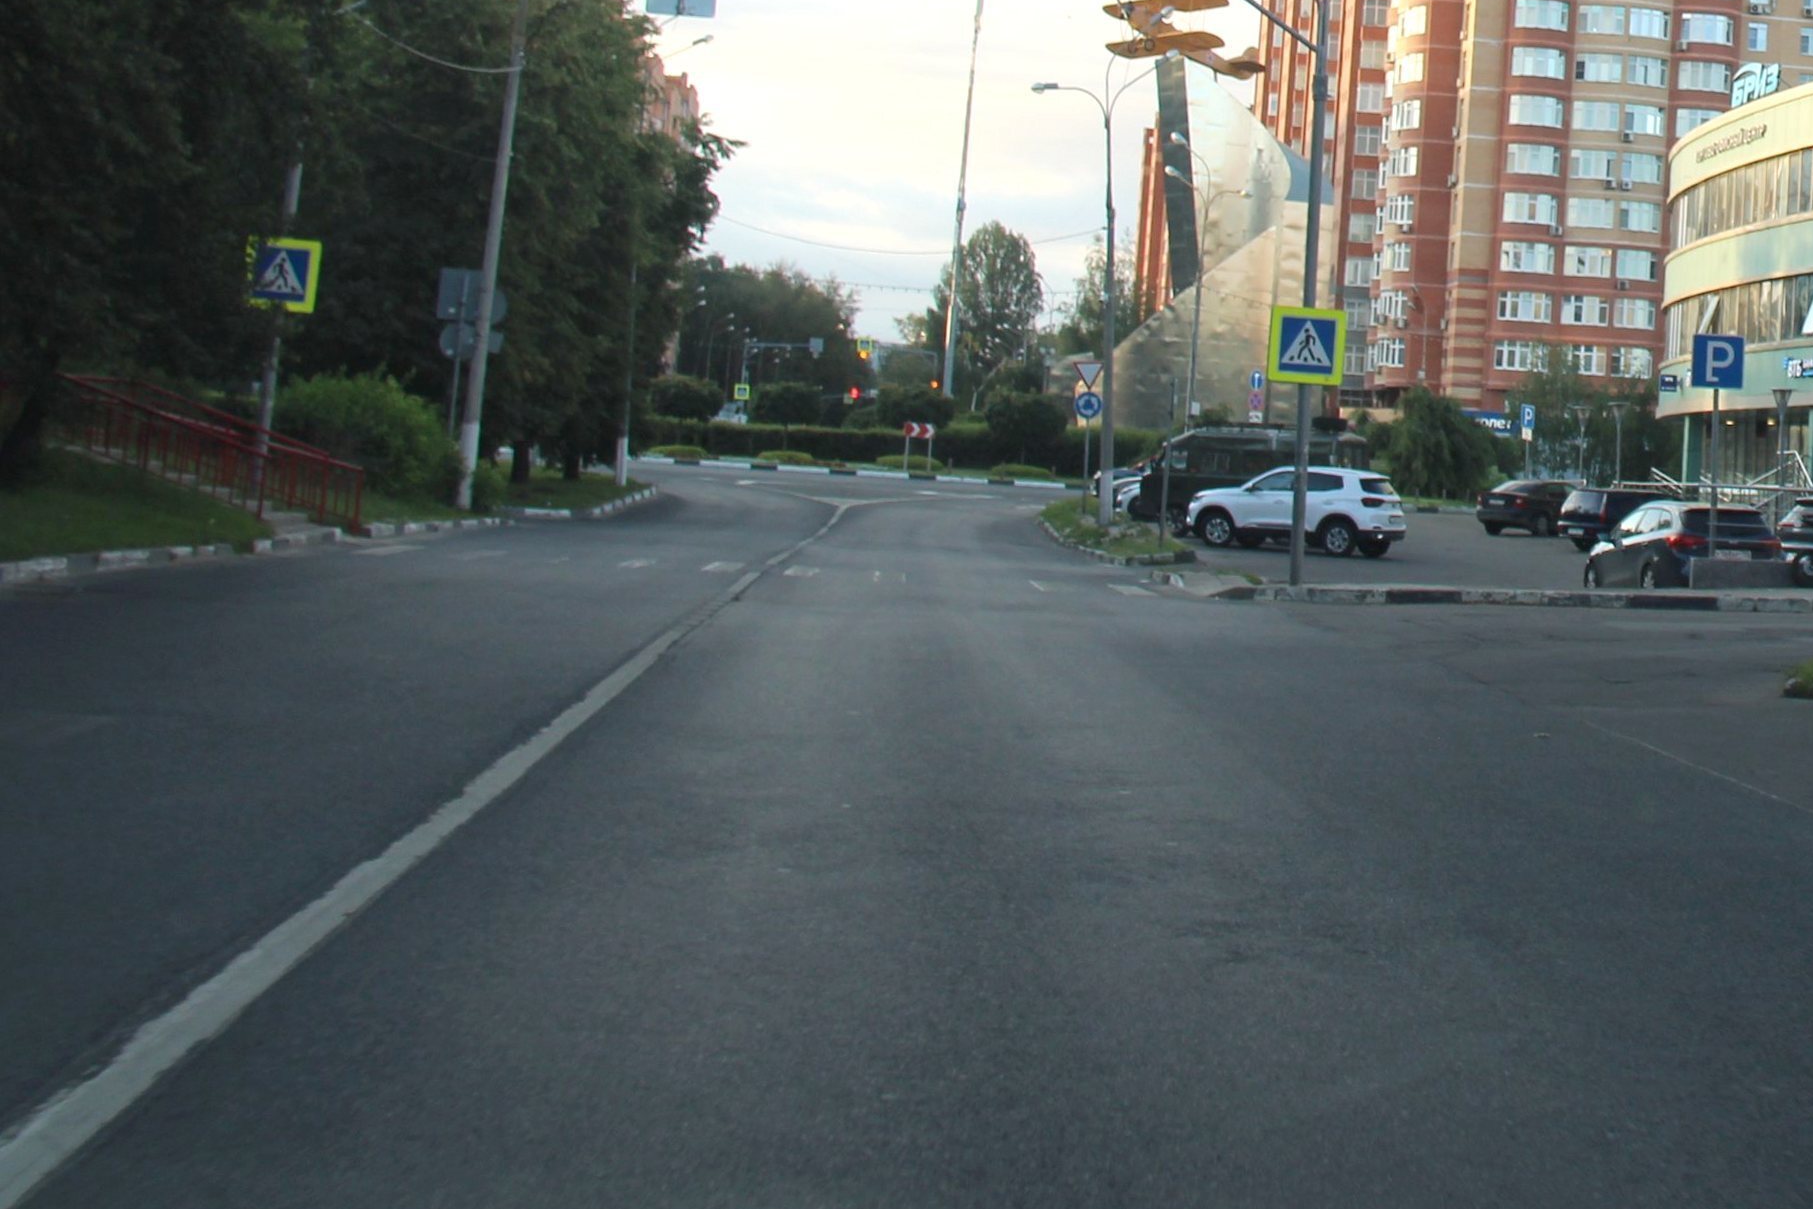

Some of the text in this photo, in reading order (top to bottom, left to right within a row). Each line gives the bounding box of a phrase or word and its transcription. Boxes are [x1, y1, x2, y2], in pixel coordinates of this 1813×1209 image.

[1731, 63, 1779, 108] БРИЗ
[1706, 340, 1735, 382] P
[1788, 359, 1802, 377] ВТБ
